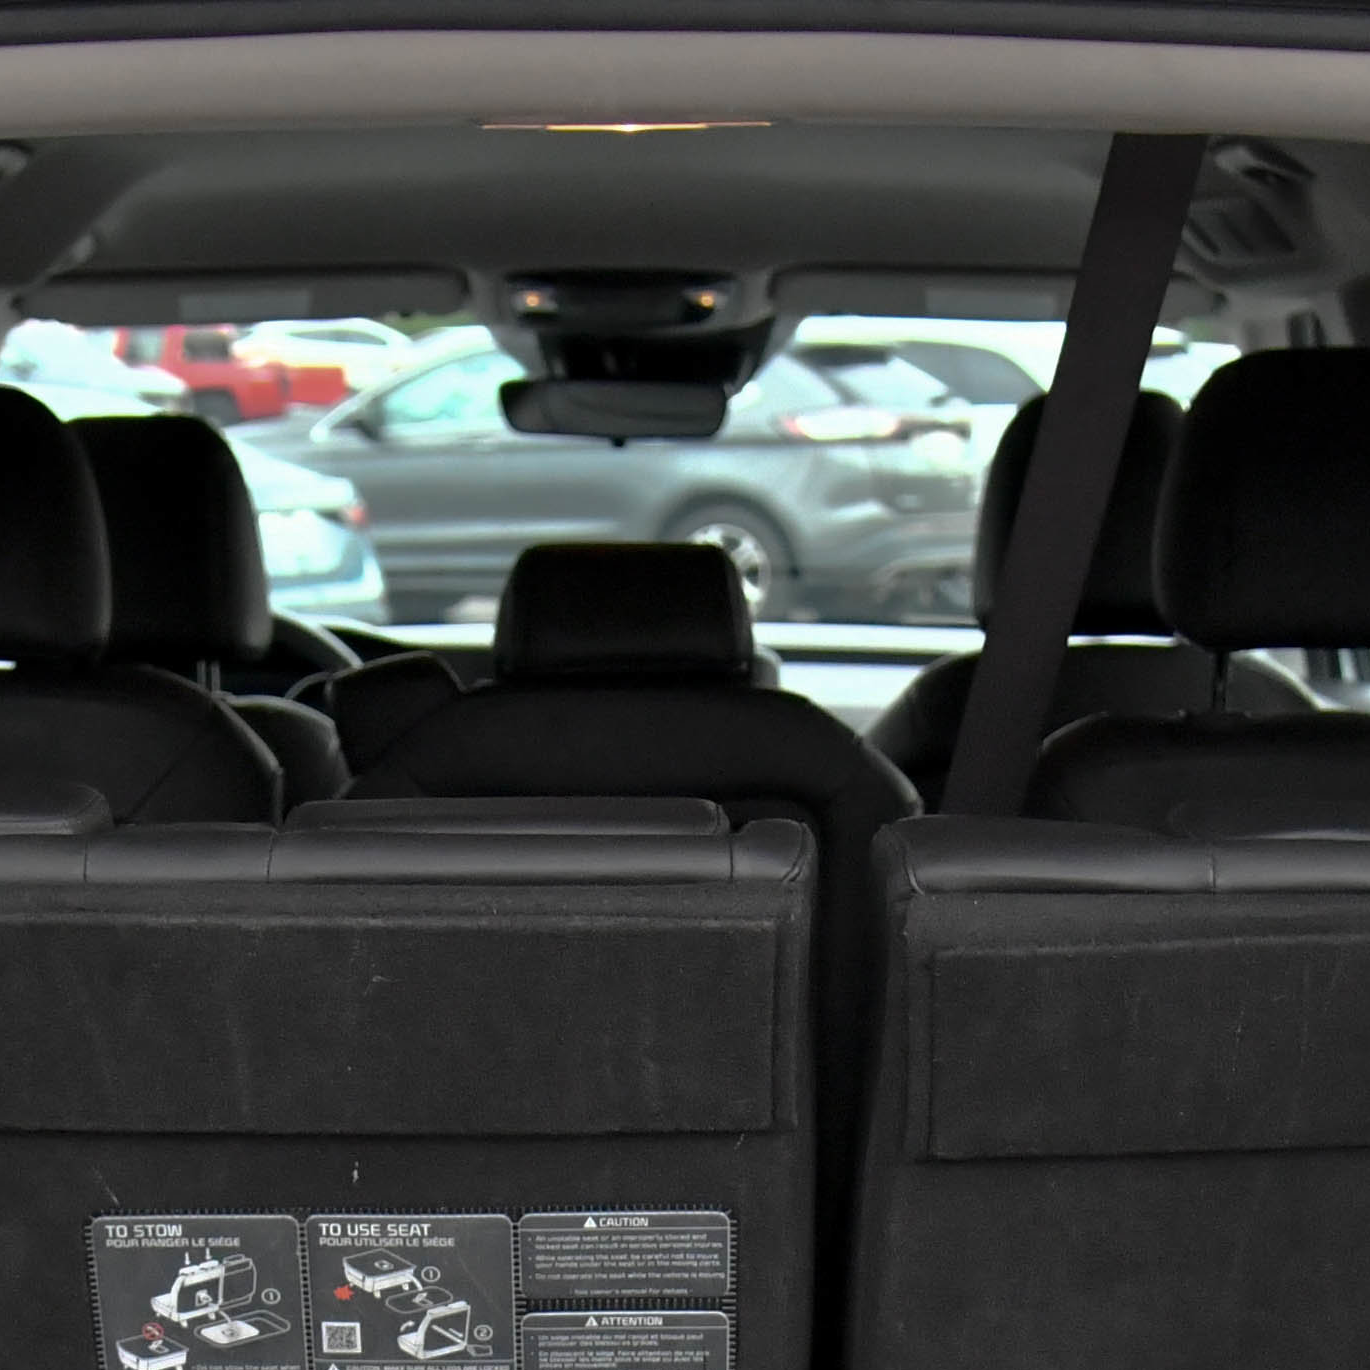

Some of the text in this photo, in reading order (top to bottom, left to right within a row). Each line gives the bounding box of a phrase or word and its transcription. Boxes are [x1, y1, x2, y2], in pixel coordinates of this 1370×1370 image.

[599, 1217, 649, 1227] CAUTION
[105, 1224, 182, 1238] TO STOW
[318, 1223, 431, 1237] TO USE SEAT
[106, 1238, 139, 1248] POUR
[141, 1238, 189, 1248] RANGER
[191, 1237, 206, 1247] LE
[319, 1237, 352, 1247] POUR
[354, 1237, 403, 1247] UTILISER
[405, 1237, 420, 1247] LE
[601, 1316, 663, 1326] ATTENTION
